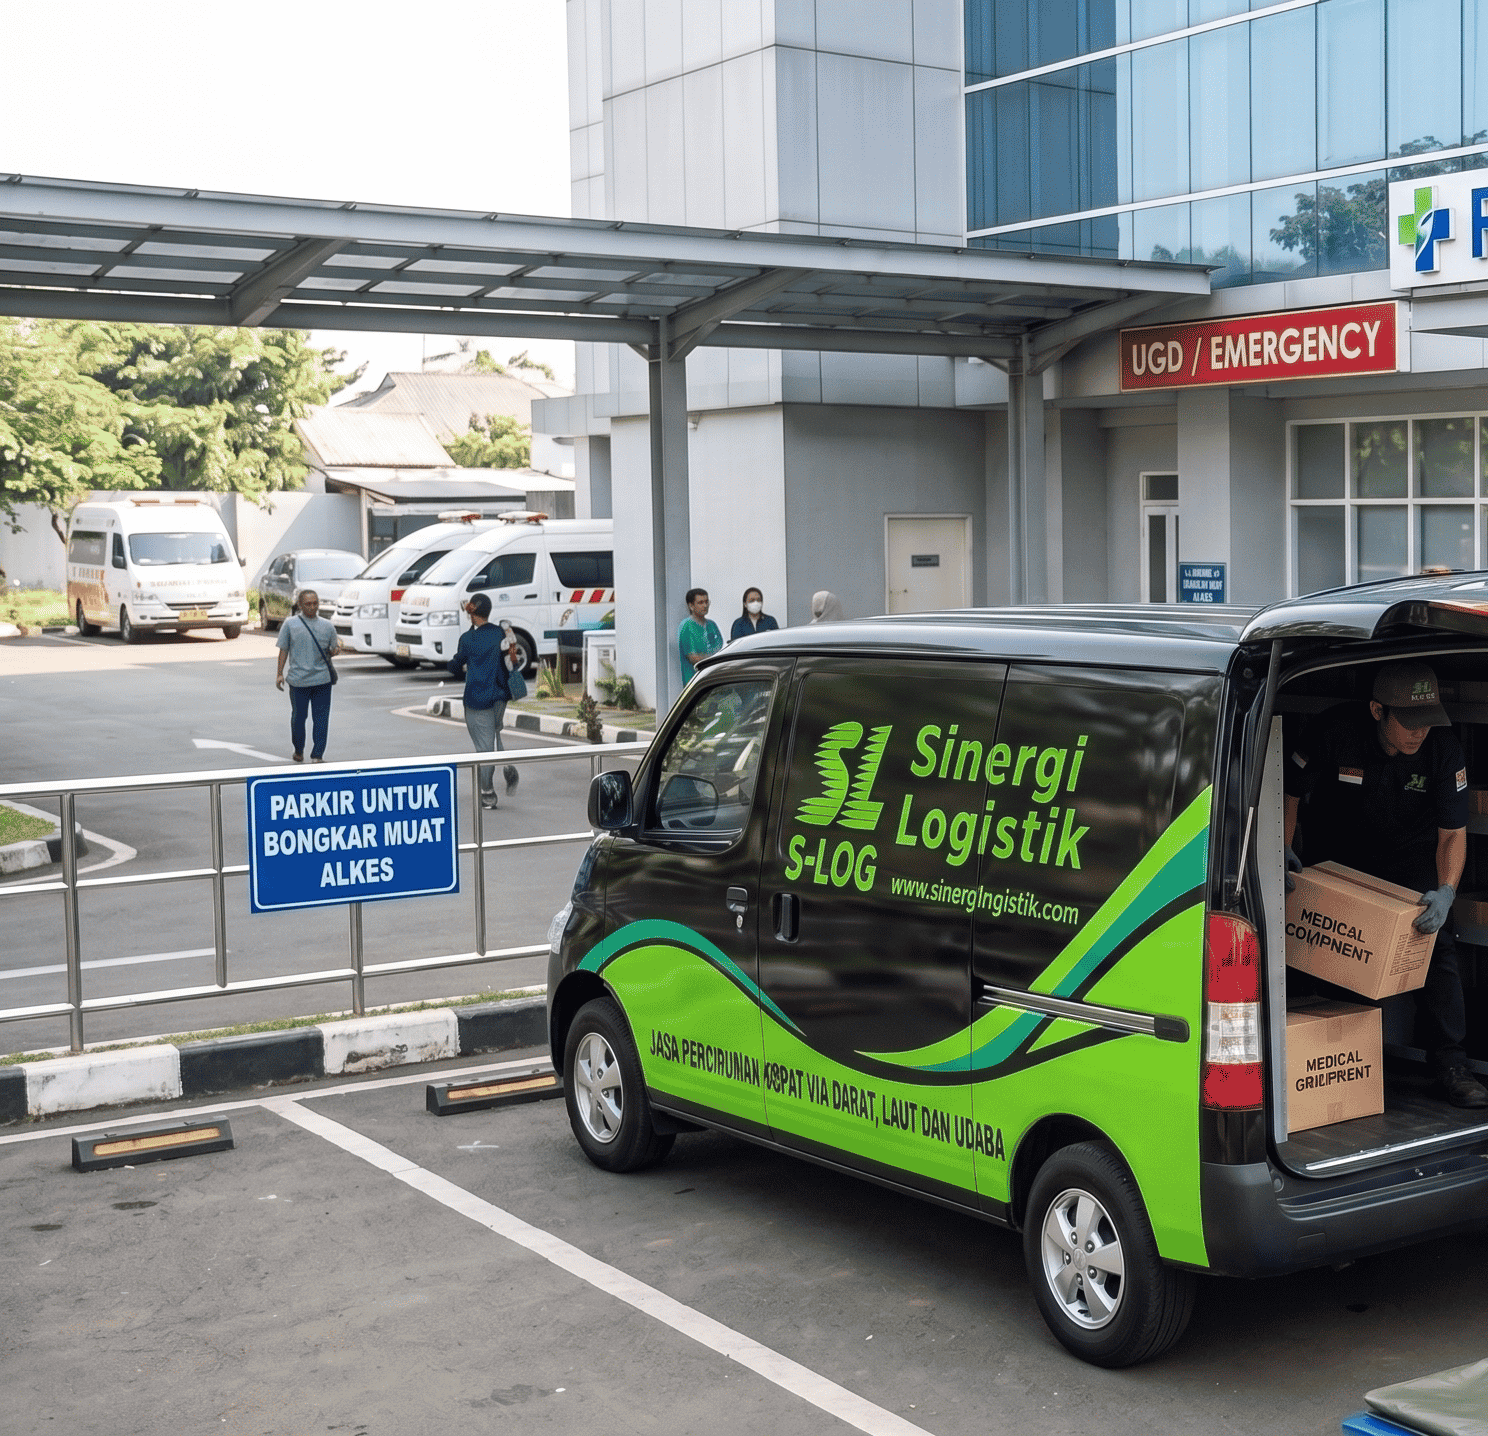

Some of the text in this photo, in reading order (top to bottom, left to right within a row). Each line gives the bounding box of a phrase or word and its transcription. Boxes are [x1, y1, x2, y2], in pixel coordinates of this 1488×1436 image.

[1132, 320, 1381, 377] UGD / EMERGENCY
[910, 724, 1089, 803] Sinergi
[270, 783, 440, 821] PARKIR UNTUK
[263, 817, 446, 857] BONGKAR MUAT
[895, 794, 1090, 870] Logistik
[320, 856, 395, 888] ALKES
[784, 834, 878, 892] S-LOG
[1300, 908, 1366, 944] MEDICAL
[1306, 1049, 1363, 1073] MEDICAL
[650, 1028, 680, 1064] JASA
[806, 1071, 830, 1108] VIA
[832, 1079, 880, 1129] DARAT,
[881, 1094, 918, 1134] LAUT
[921, 1105, 951, 1144] DAN
